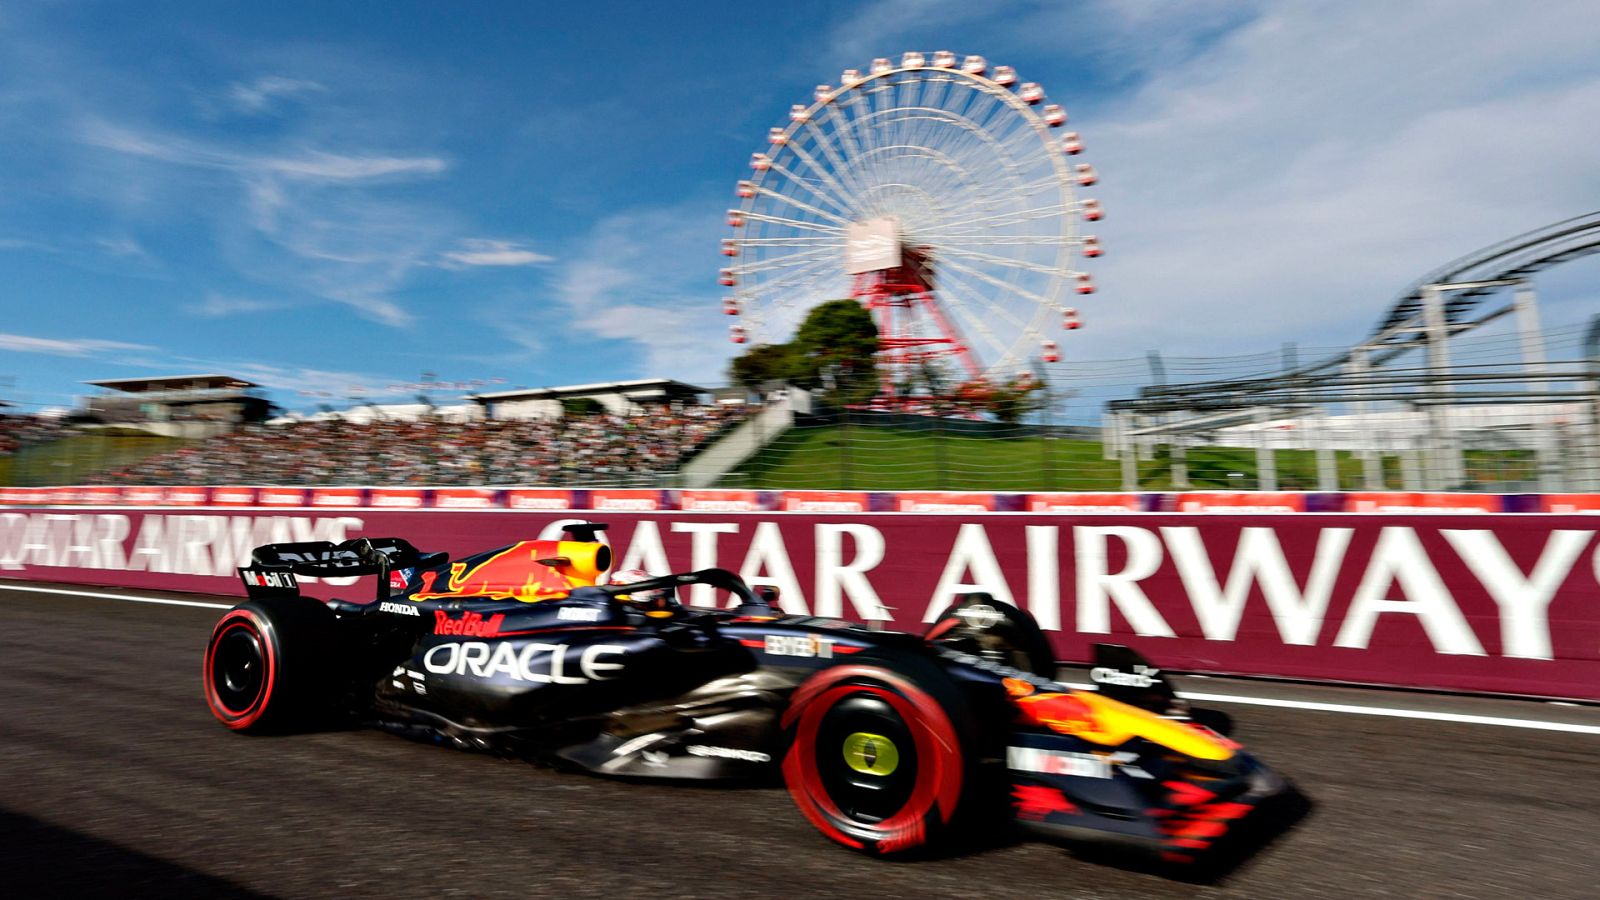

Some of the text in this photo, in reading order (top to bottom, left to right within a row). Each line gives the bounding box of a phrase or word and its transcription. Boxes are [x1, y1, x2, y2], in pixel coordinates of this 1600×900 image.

[379, 602, 420, 616] HONDA
[922, 523, 1600, 660] AIRWAY
[423, 641, 629, 685] ORACLE
